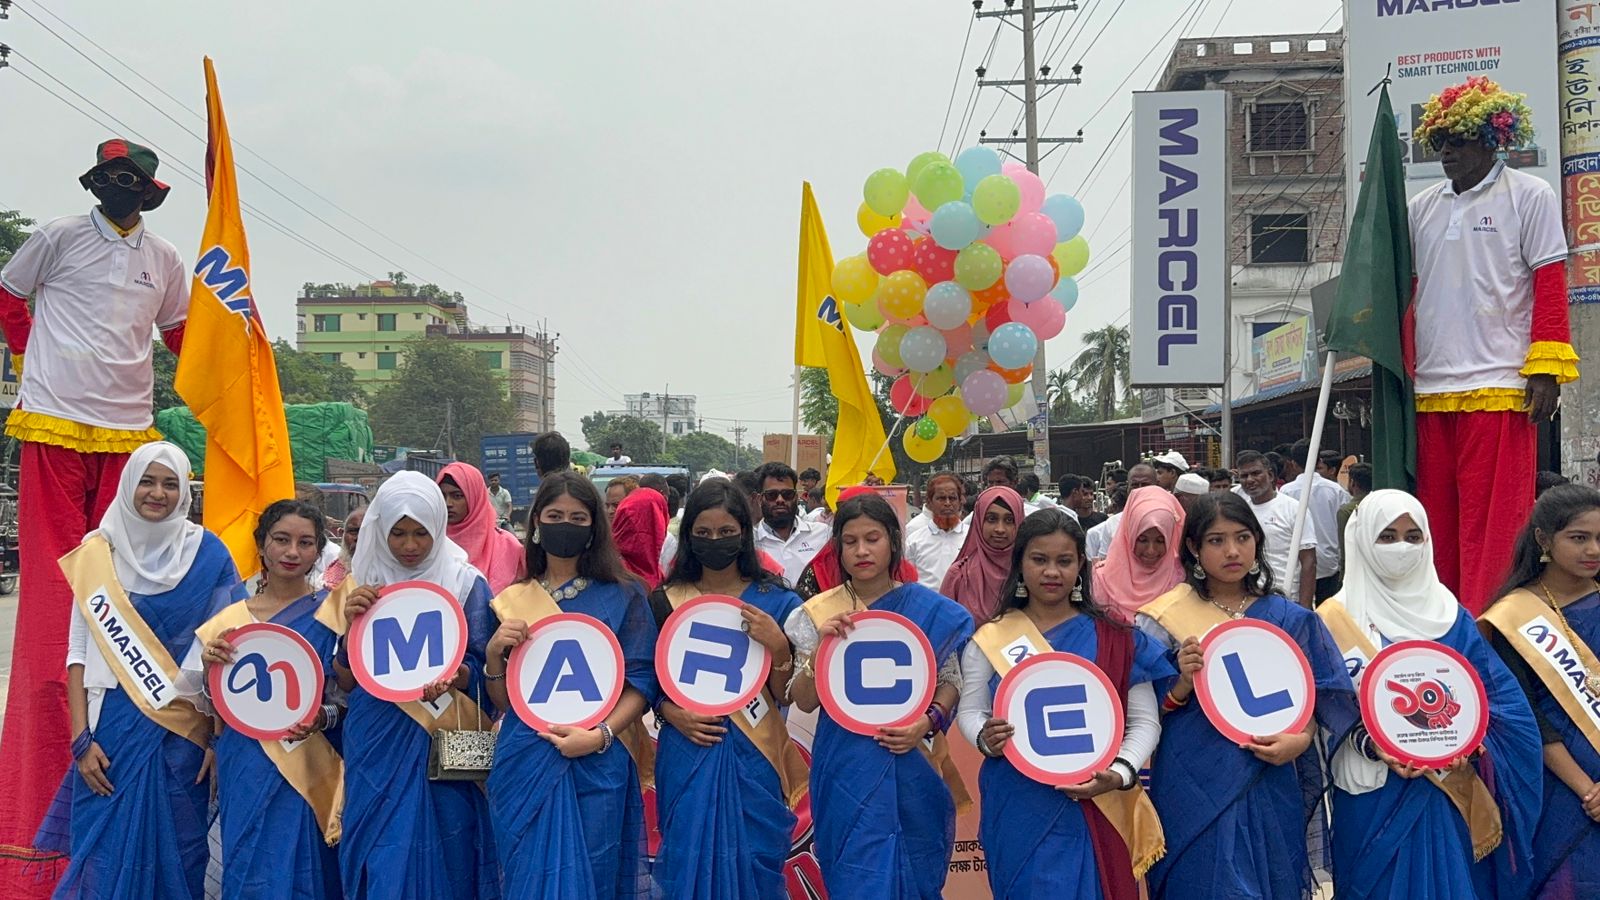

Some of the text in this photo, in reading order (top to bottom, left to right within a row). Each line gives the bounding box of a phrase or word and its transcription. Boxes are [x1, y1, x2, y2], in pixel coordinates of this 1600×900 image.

[1397, 46, 1501, 66] BEST PRODUCTS WITH
[1398, 58, 1500, 78] SMART TECHNOLOGY
[1158, 108, 1198, 366] MARCEL
[104, 616, 166, 702] MARCEL
[373, 611, 443, 676] M
[529, 640, 603, 704] A
[679, 622, 749, 694] R
[844, 641, 913, 706] C
[1222, 652, 1294, 718] L
[1025, 684, 1095, 756] E
